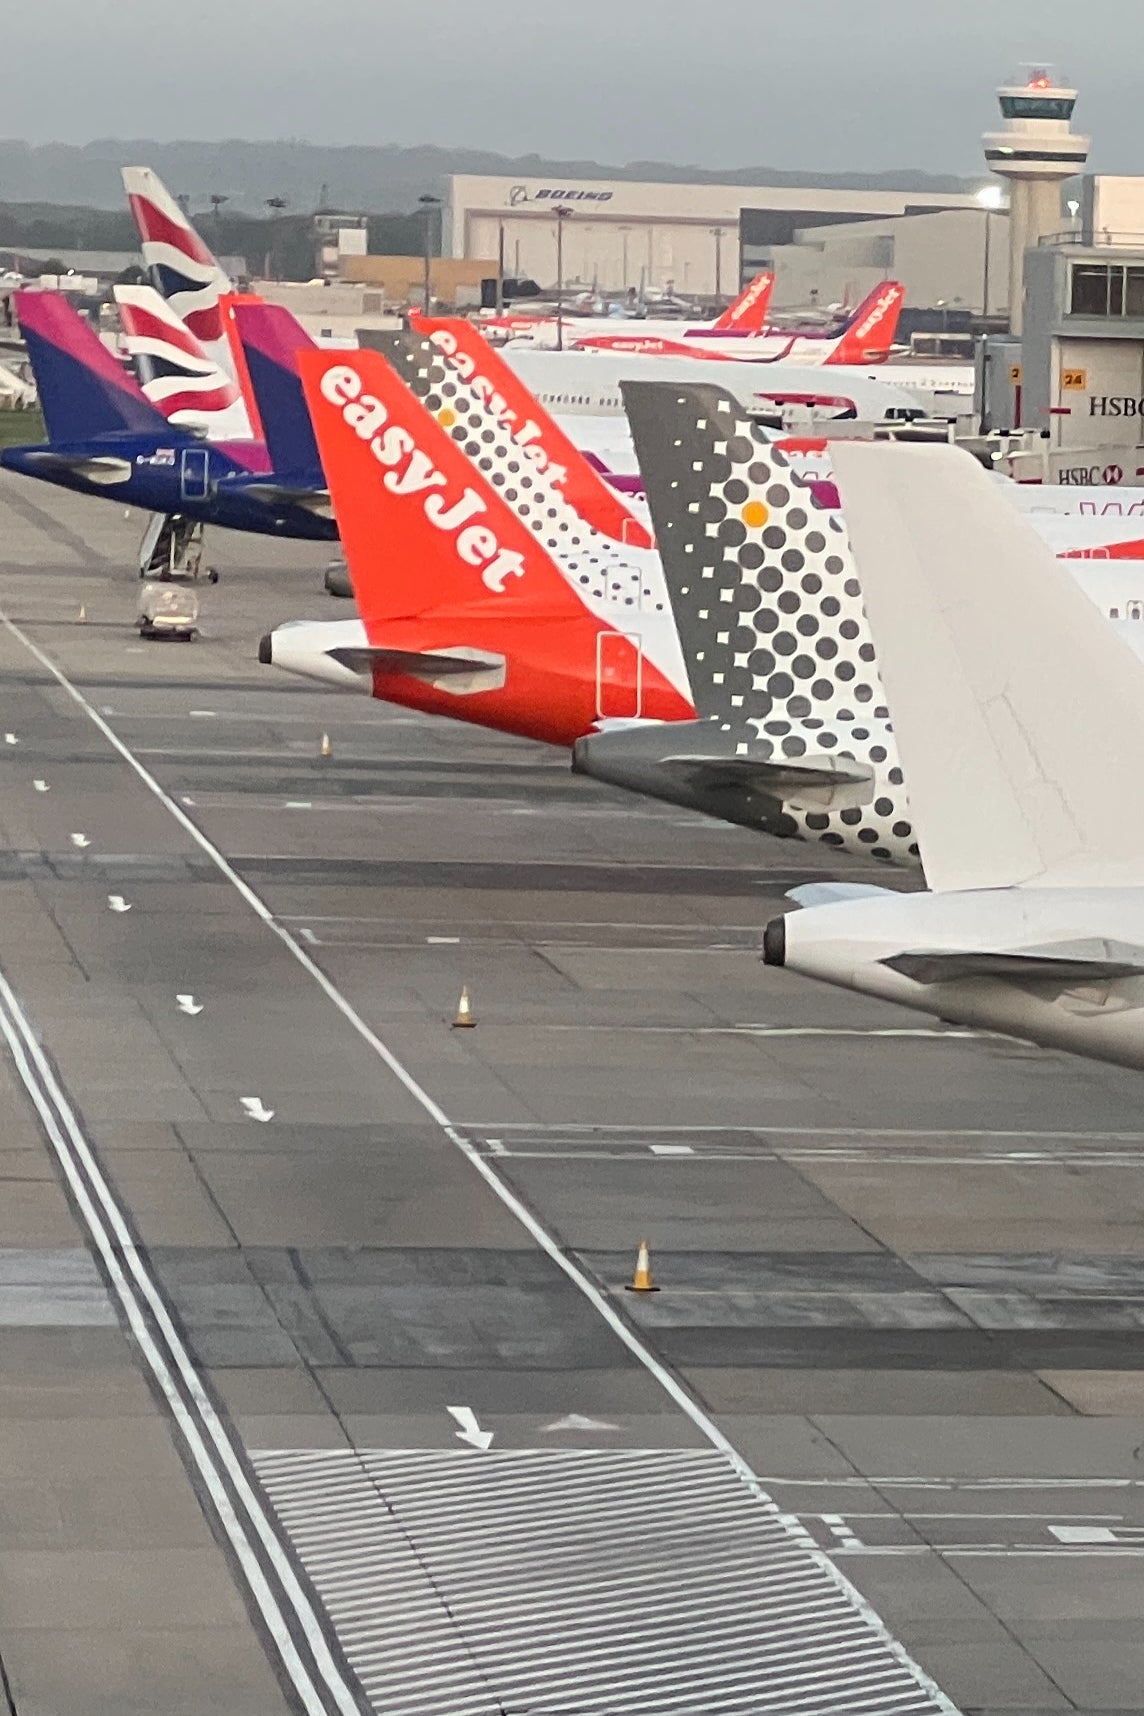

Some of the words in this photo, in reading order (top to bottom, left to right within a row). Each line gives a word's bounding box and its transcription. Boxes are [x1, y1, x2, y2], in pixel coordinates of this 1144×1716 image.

[535, 189, 613, 200] BOEING
[320, 365, 525, 593] easyJet
[1059, 466, 1100, 486] HSBC
